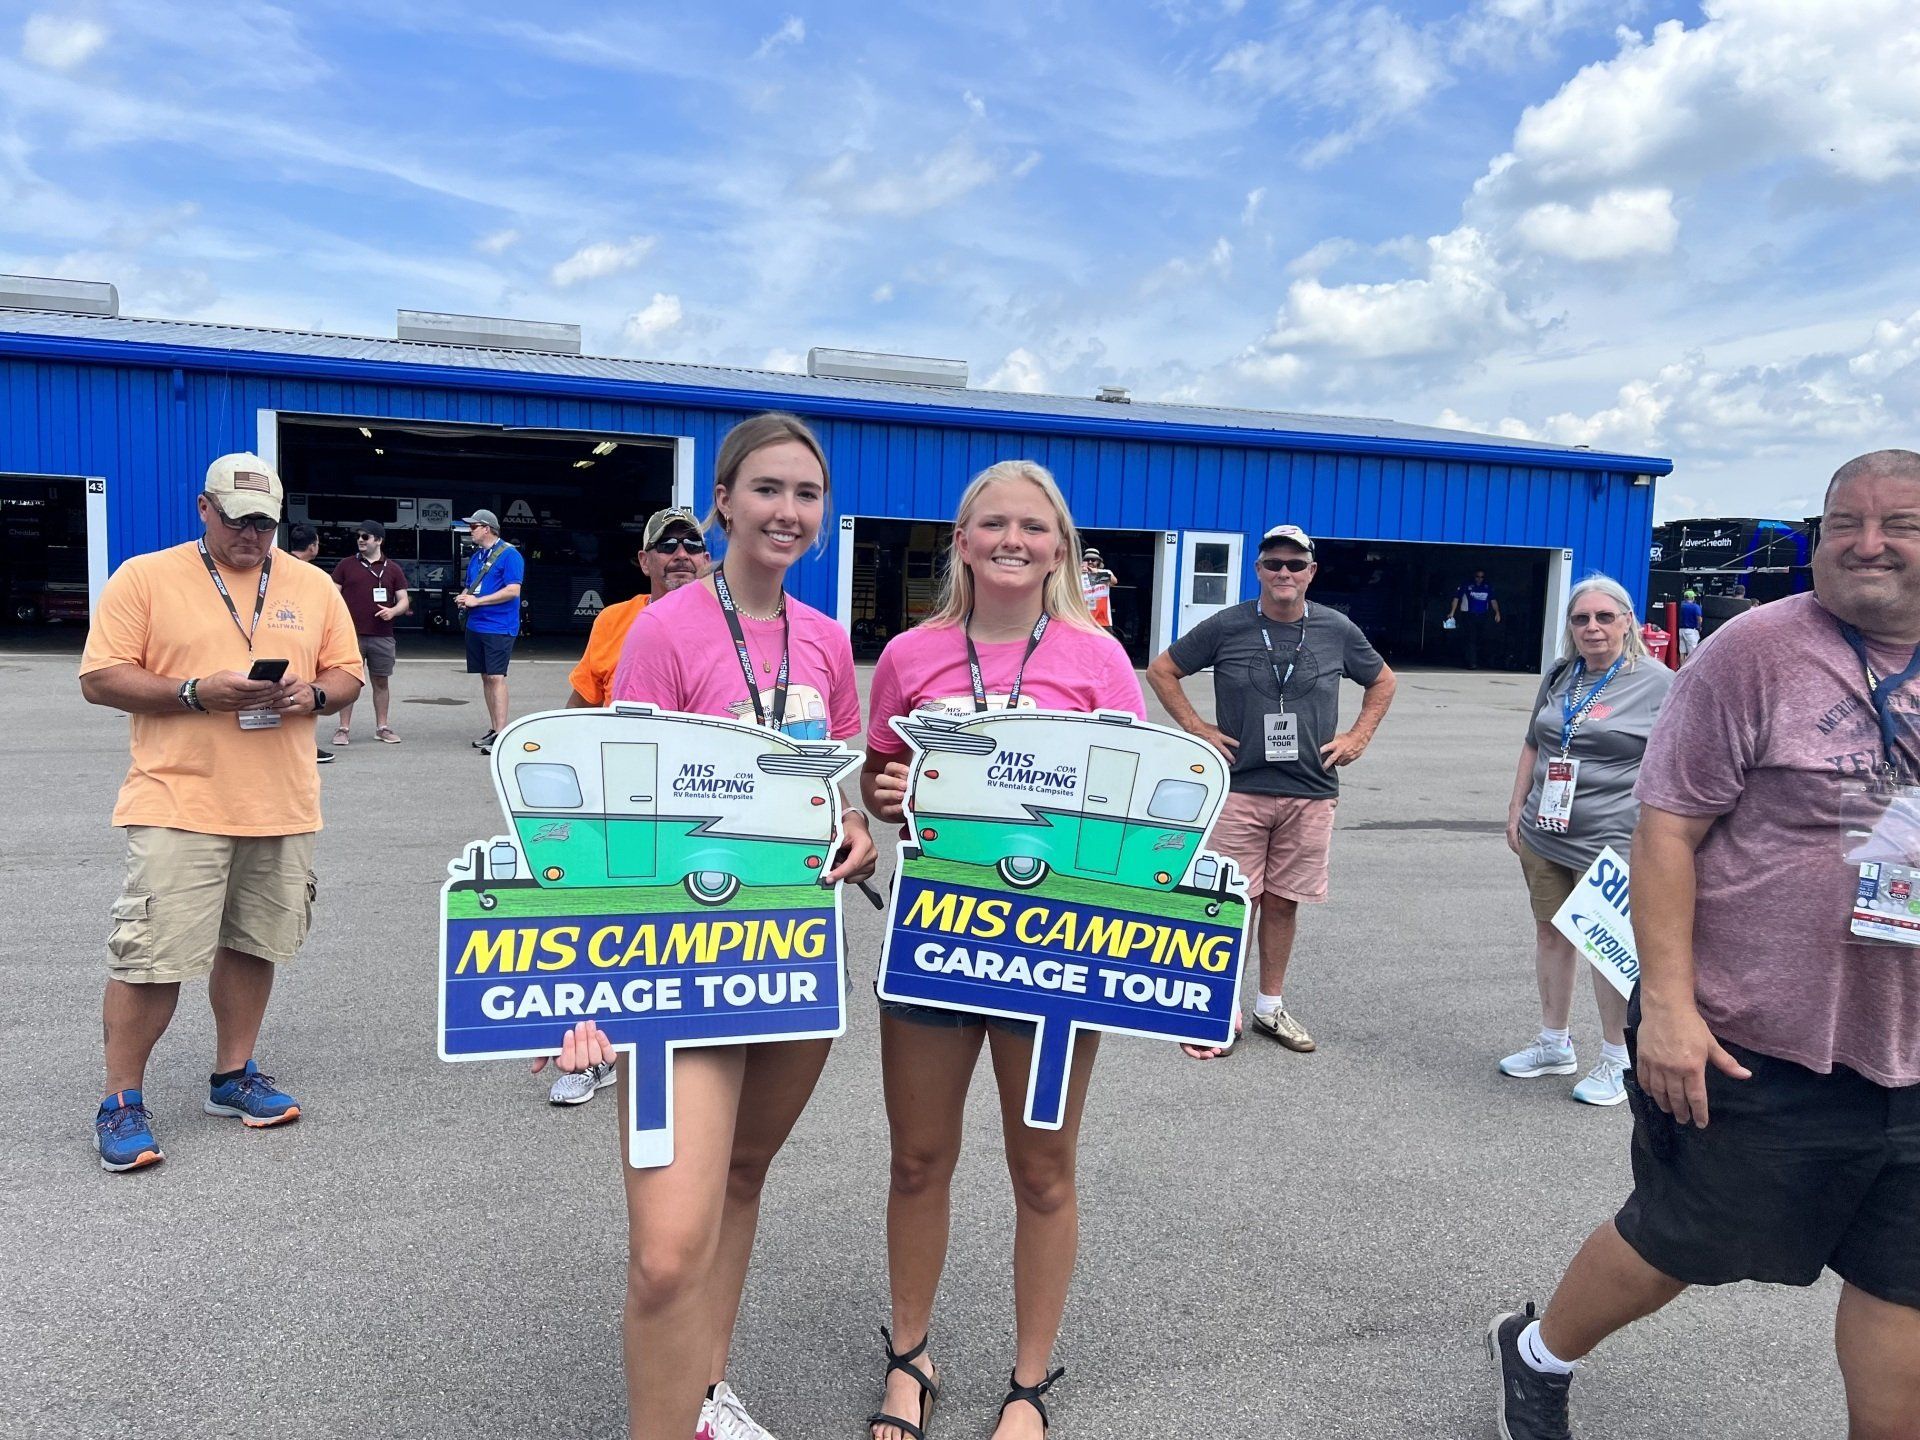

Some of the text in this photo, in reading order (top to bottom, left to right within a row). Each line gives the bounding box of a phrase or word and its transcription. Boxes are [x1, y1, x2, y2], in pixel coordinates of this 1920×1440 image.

[89, 483, 103, 492] 43
[422, 509, 448, 518] BUSCH
[842, 520, 853, 529] 40
[1166, 535, 1176, 543] 39
[427, 567, 444, 582] 4
[716, 579, 734, 611] NASCAR
[267, 623, 304, 631] SALTWATER
[738, 649, 756, 685] NASCAR
[970, 663, 984, 695] NASCAR
[995, 751, 1035, 768] MIS
[679, 764, 715, 777] MIS
[987, 765, 1078, 789] CAMPING
[672, 778, 755, 793] CAMPING
[999, 781, 1027, 791] Rentals
[1035, 786, 1074, 797] Campsites
[902, 889, 1234, 972] MIS CAMPING
[455, 918, 827, 975] MIS CAMPING
[914, 942, 1212, 1013] GARAGE TOUR
[480, 971, 818, 1020] GARAGE TOUR
